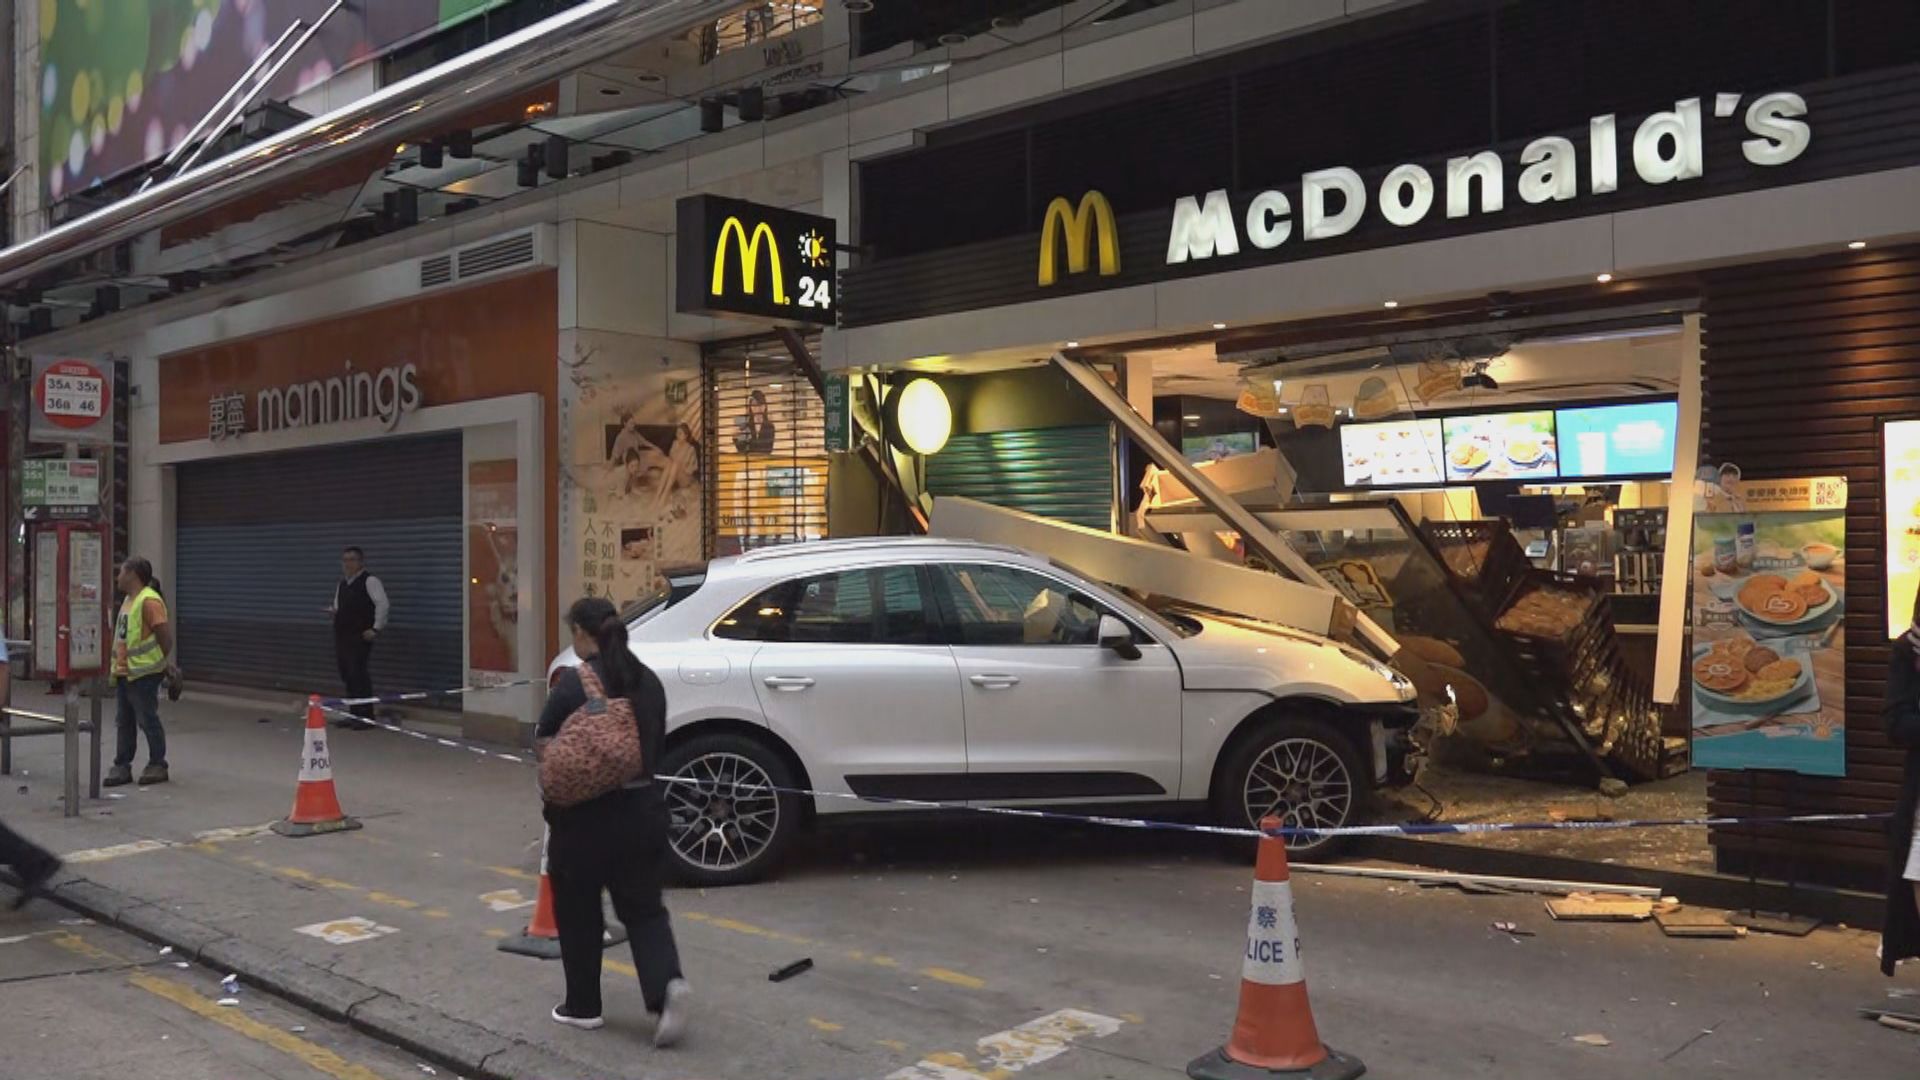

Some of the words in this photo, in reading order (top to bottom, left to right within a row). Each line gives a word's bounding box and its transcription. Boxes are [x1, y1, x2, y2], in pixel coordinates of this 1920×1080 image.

[1166, 92, 1811, 265] McDonald's
[798, 275, 831, 309] 24
[47, 378, 71, 390] 35A
[77, 380, 99, 393] 35X
[257, 359, 421, 432] mannings
[47, 398, 71, 410] 36B
[79, 400, 95, 412] 46
